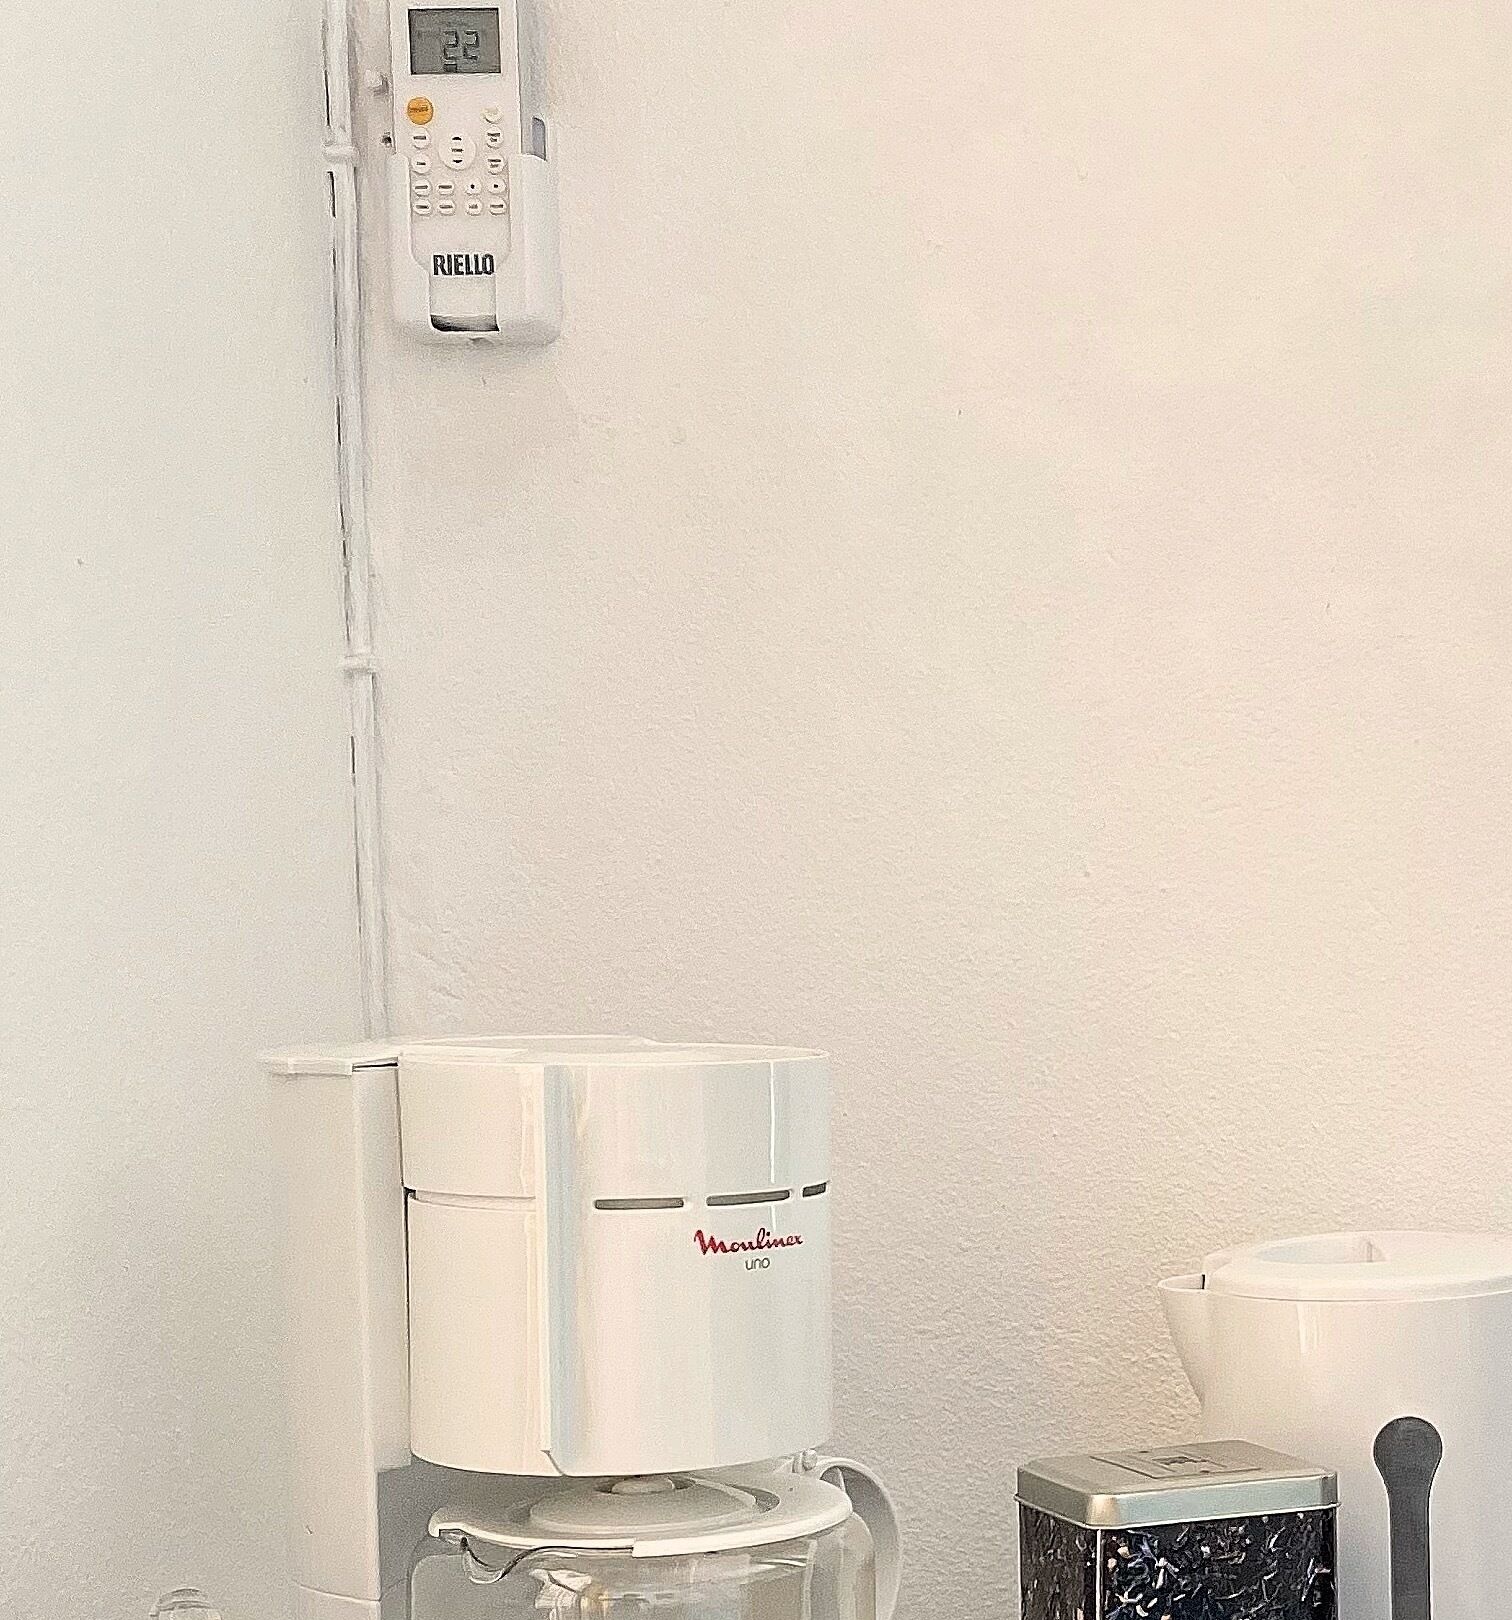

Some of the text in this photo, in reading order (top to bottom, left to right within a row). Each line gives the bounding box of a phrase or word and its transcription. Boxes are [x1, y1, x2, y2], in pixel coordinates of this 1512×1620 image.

[443, 30, 479, 60] 22
[433, 254, 495, 276] RIELLO
[745, 1257, 770, 1270] uno
